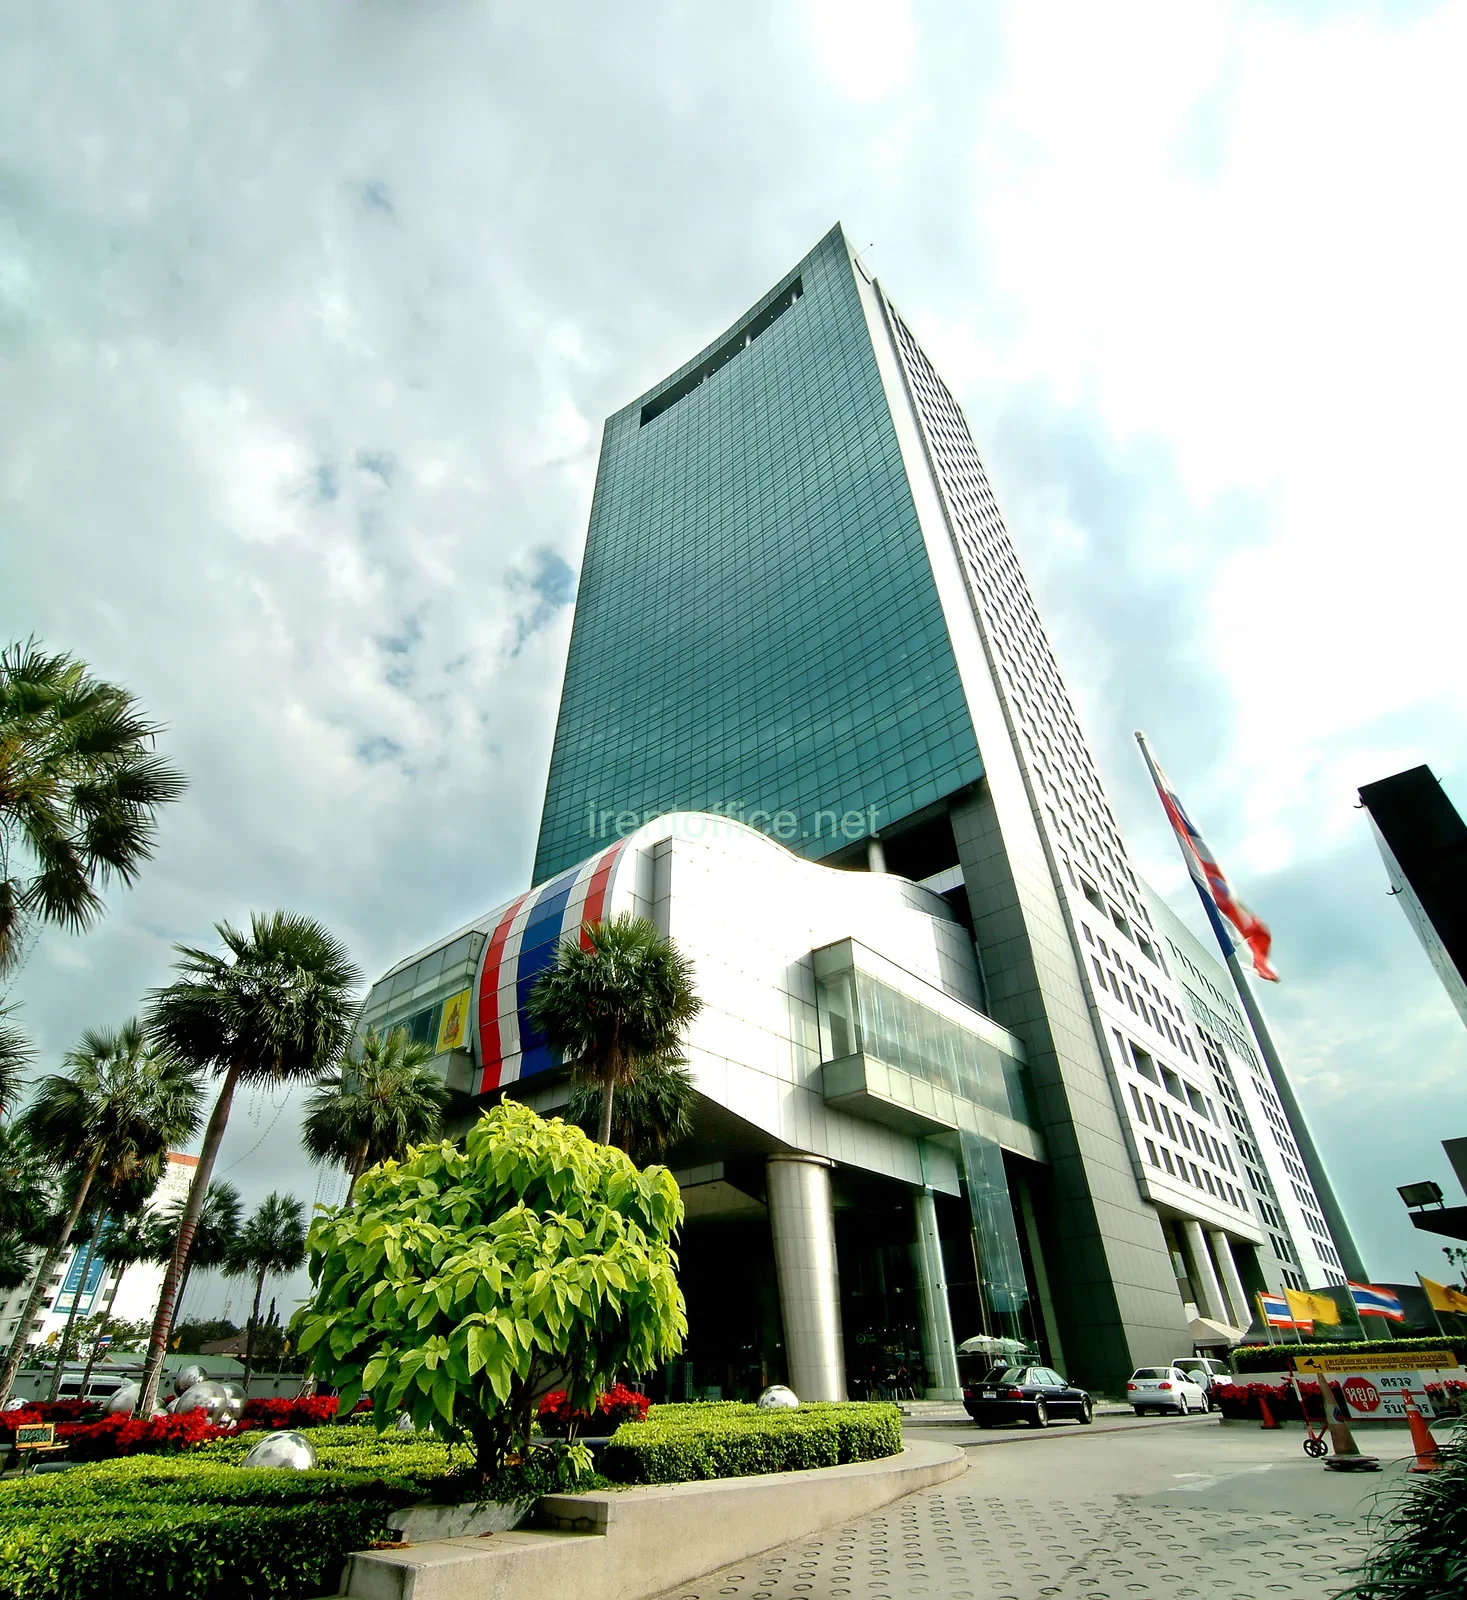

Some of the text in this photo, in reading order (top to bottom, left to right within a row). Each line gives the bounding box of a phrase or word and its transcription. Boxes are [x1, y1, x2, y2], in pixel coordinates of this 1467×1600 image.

[1342, 1364, 1368, 1372] premises
[1380, 1377, 1411, 1387] ตรวจ
[1345, 1387, 1379, 1410] หยุด
